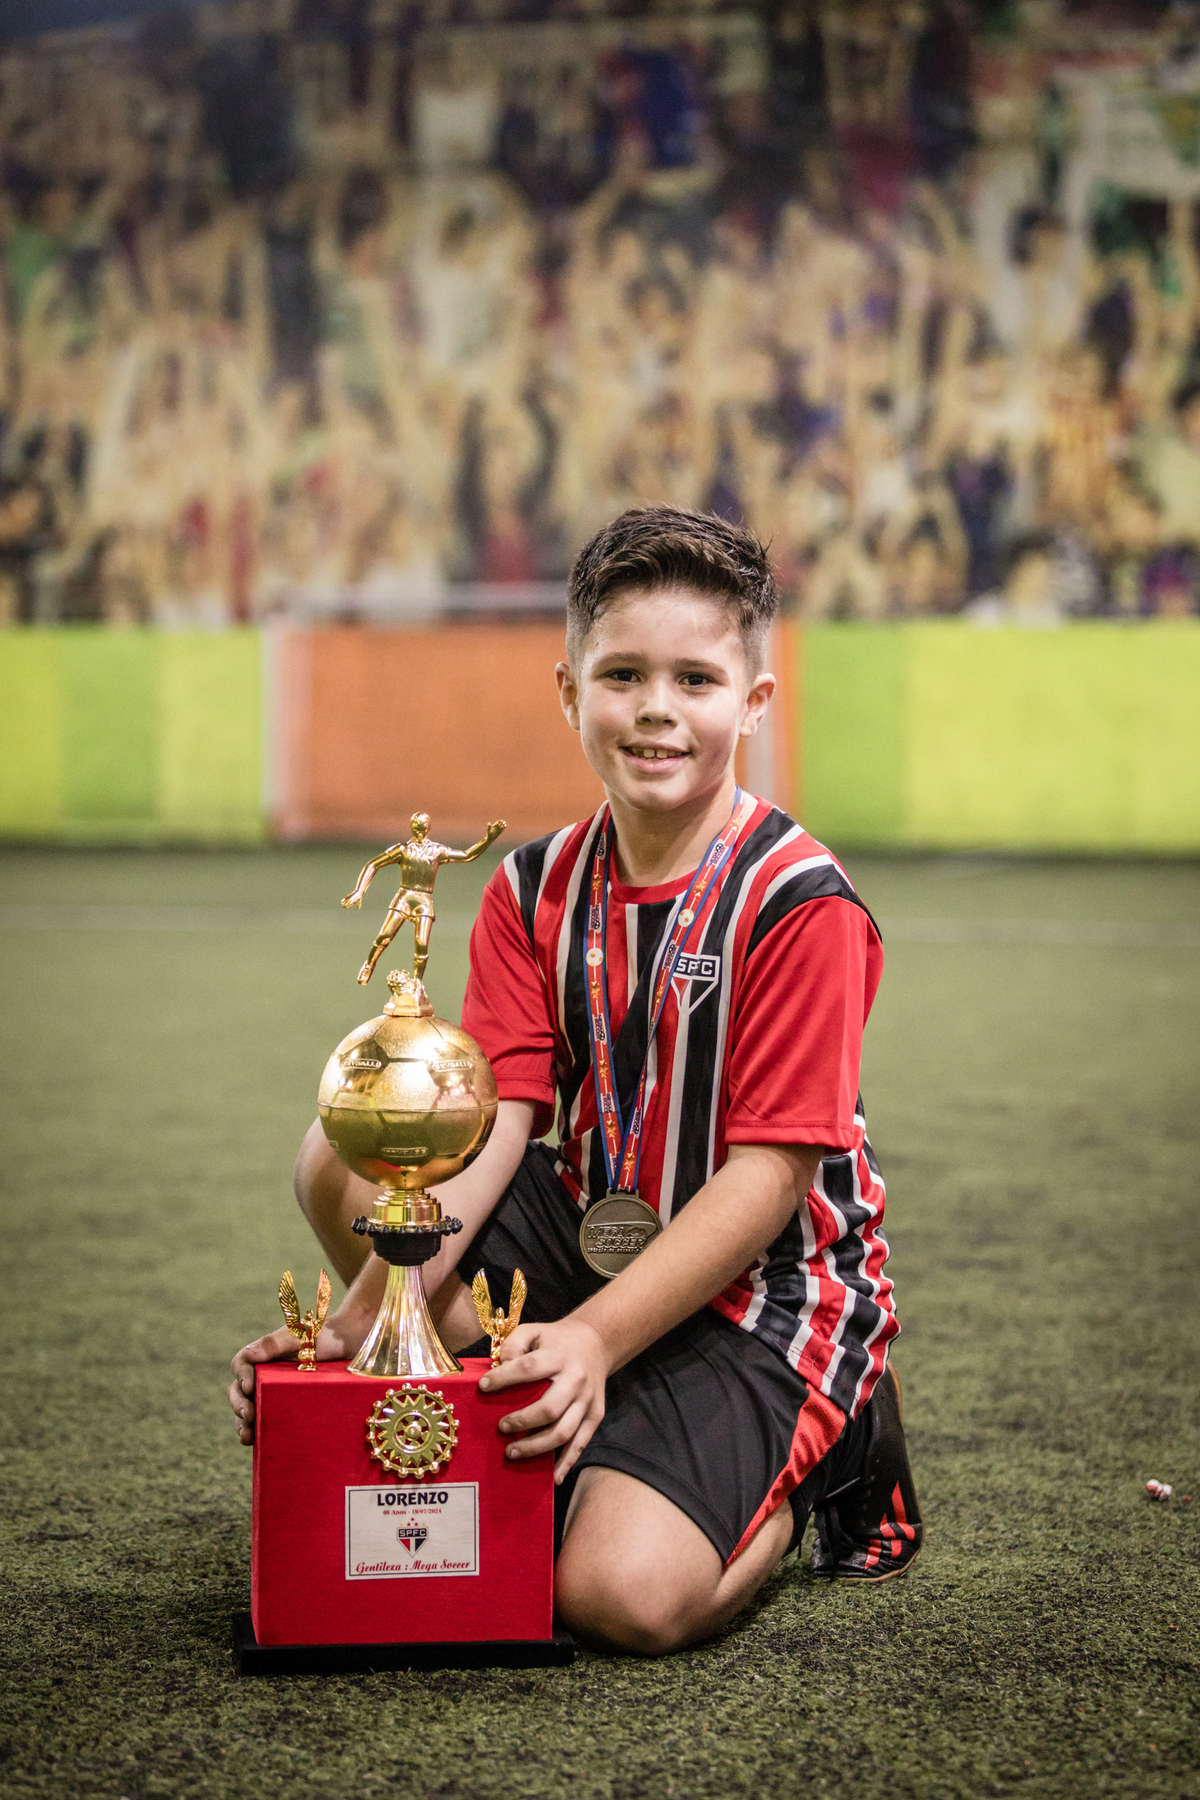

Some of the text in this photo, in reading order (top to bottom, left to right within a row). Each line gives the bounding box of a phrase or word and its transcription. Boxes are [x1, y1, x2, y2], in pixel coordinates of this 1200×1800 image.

[676, 959, 713, 975] SPC
[595, 1236, 645, 1248] SOCCER
[377, 1491, 448, 1507] LORENZO
[399, 1529, 426, 1537] SPFC
[355, 1561, 401, 1575] Gentileza
[409, 1560, 437, 1572] Mega
[440, 1559, 470, 1570] Soccer
